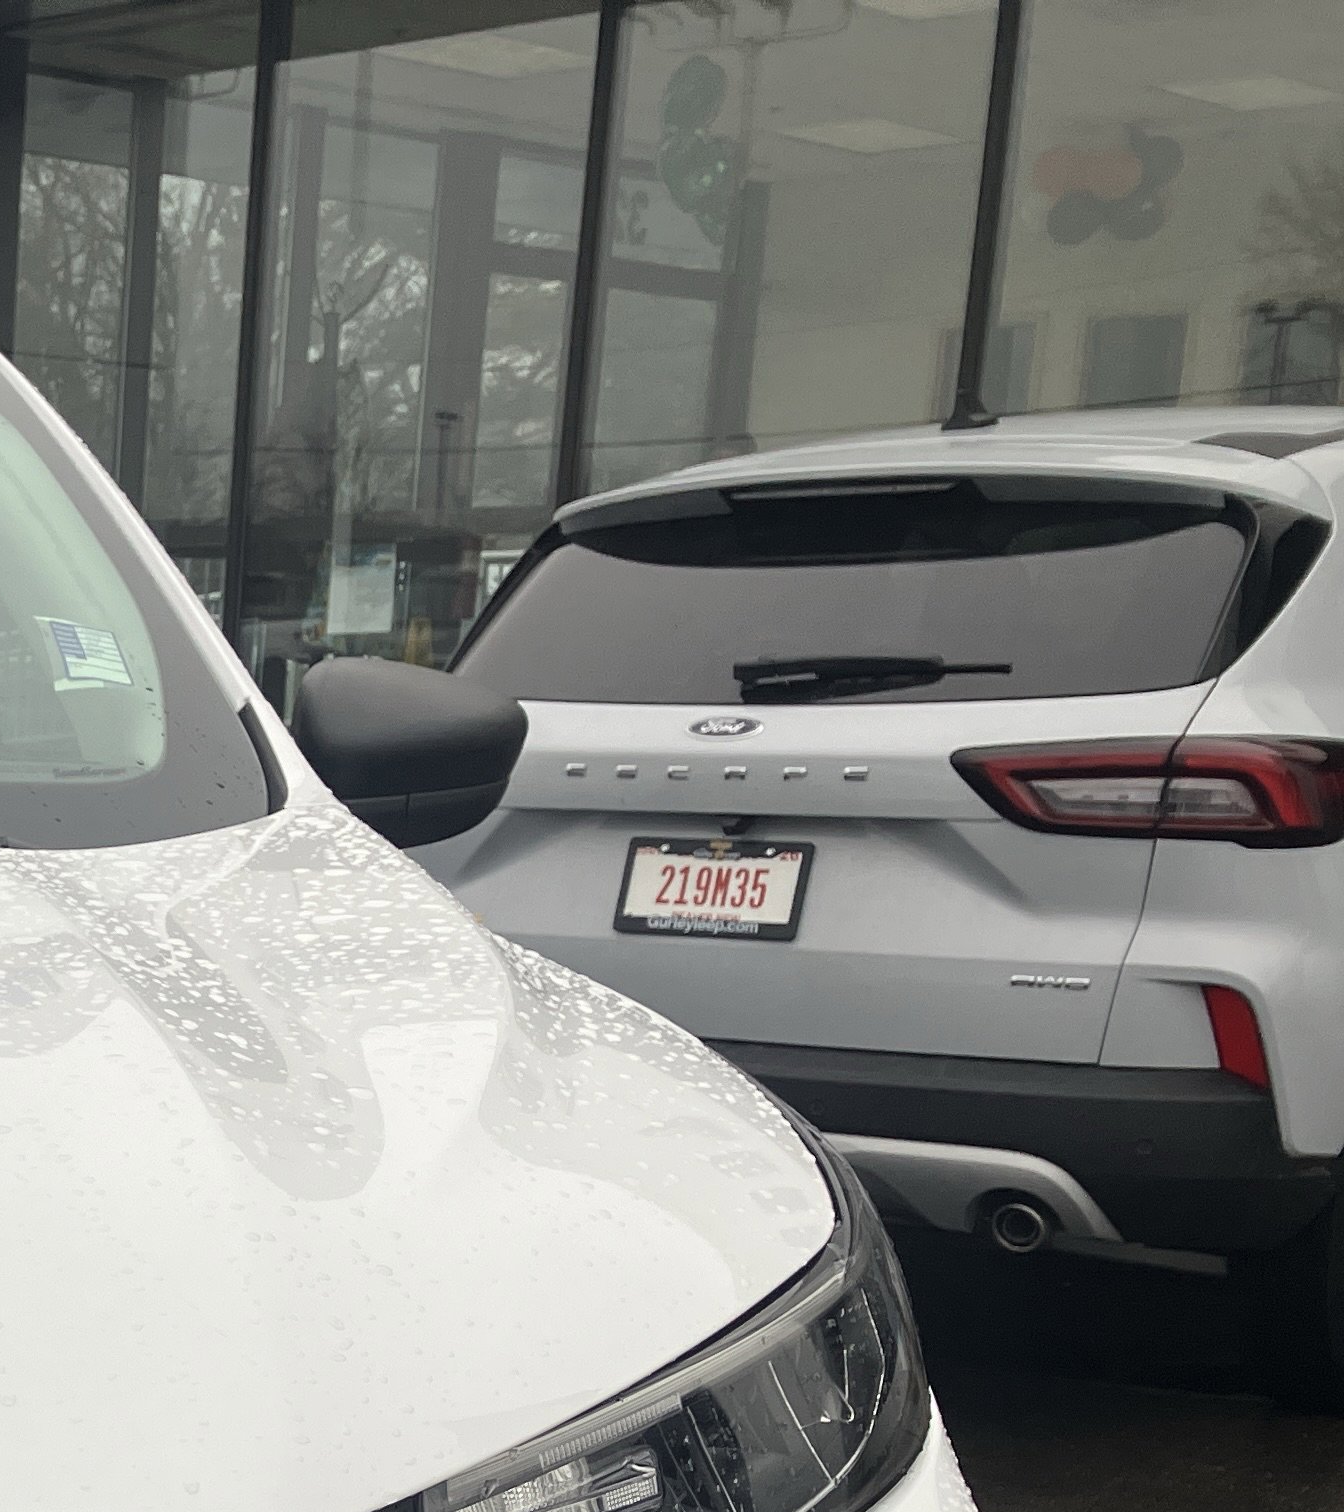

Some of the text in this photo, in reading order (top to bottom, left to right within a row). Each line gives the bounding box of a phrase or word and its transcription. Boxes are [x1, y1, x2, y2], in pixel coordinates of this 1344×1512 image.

[700, 717, 747, 734] Ford
[566, 763, 869, 780] ESCAPE
[655, 864, 770, 909] 219M35
